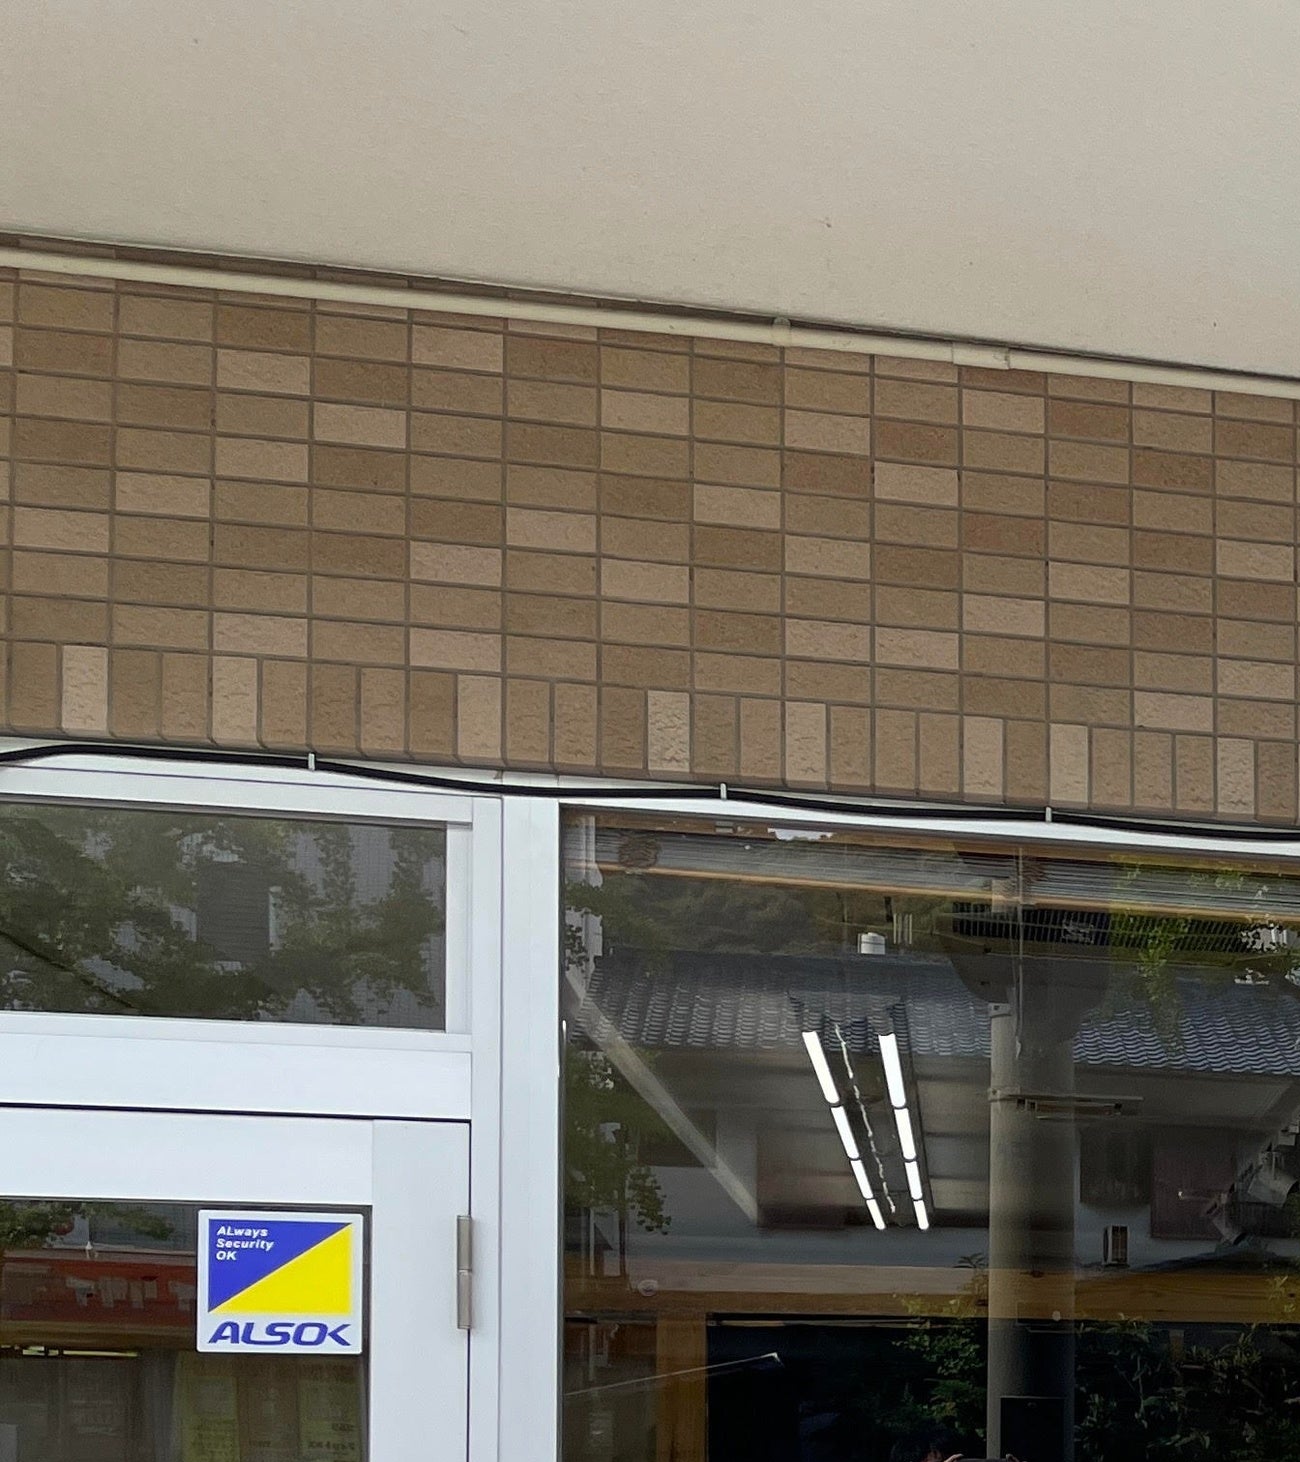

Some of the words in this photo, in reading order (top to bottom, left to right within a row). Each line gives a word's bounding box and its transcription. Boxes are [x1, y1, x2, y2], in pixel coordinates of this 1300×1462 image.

[216, 1239, 274, 1251] Security
[216, 1251, 237, 1260] OK
[208, 1321, 352, 1346] ALSOK
